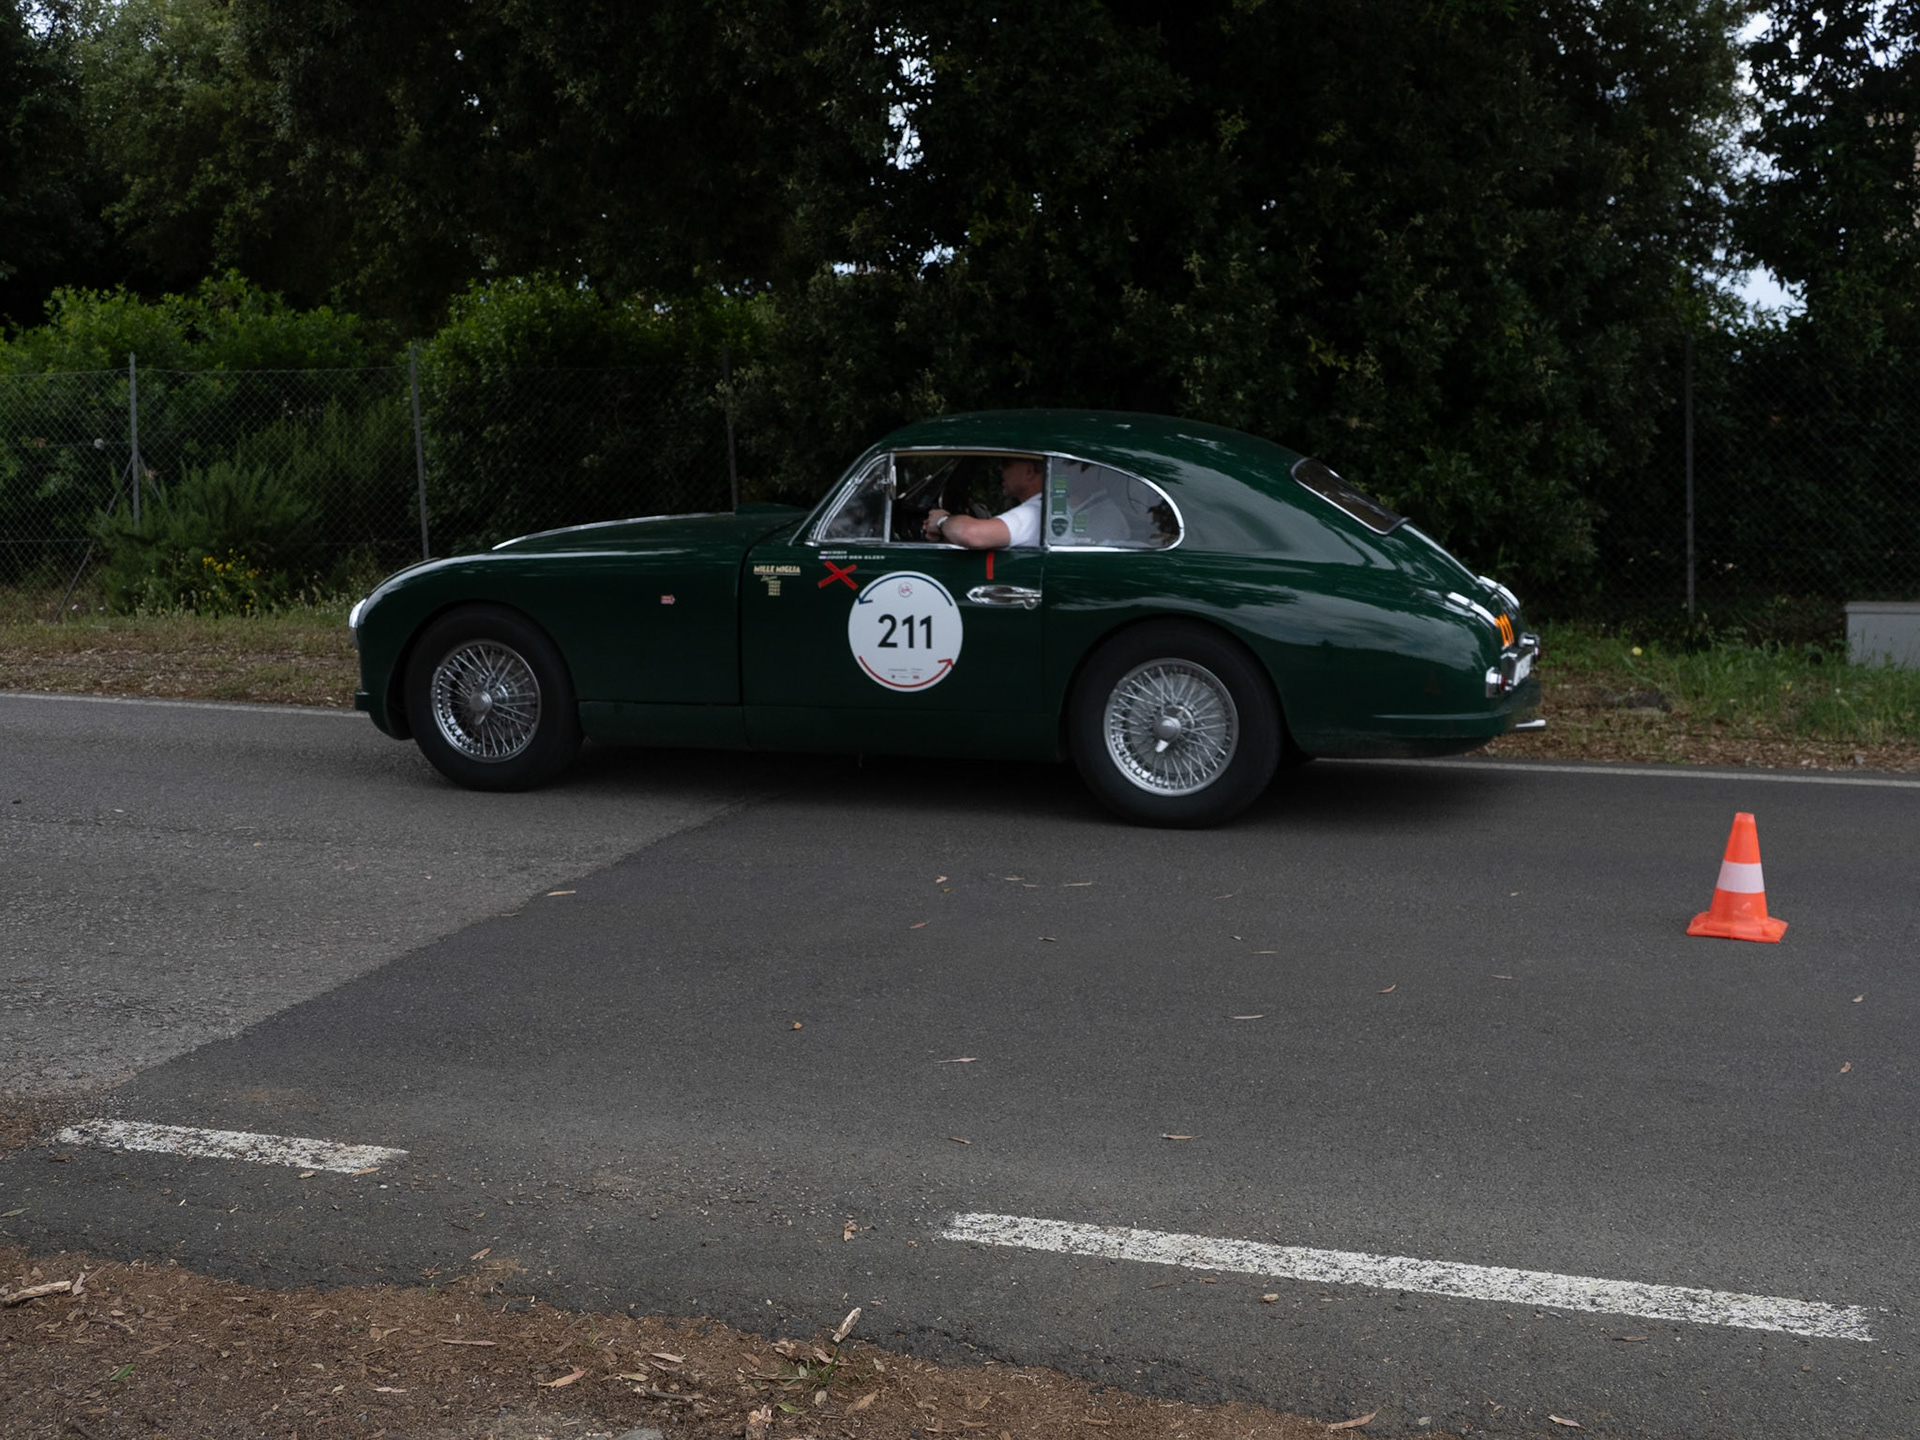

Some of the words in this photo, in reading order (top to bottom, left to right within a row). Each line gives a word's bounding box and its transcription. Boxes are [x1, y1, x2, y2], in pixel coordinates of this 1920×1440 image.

[754, 565, 775, 573] MILLE
[776, 565, 801, 573] MIGLIA
[877, 613, 932, 650] 211
